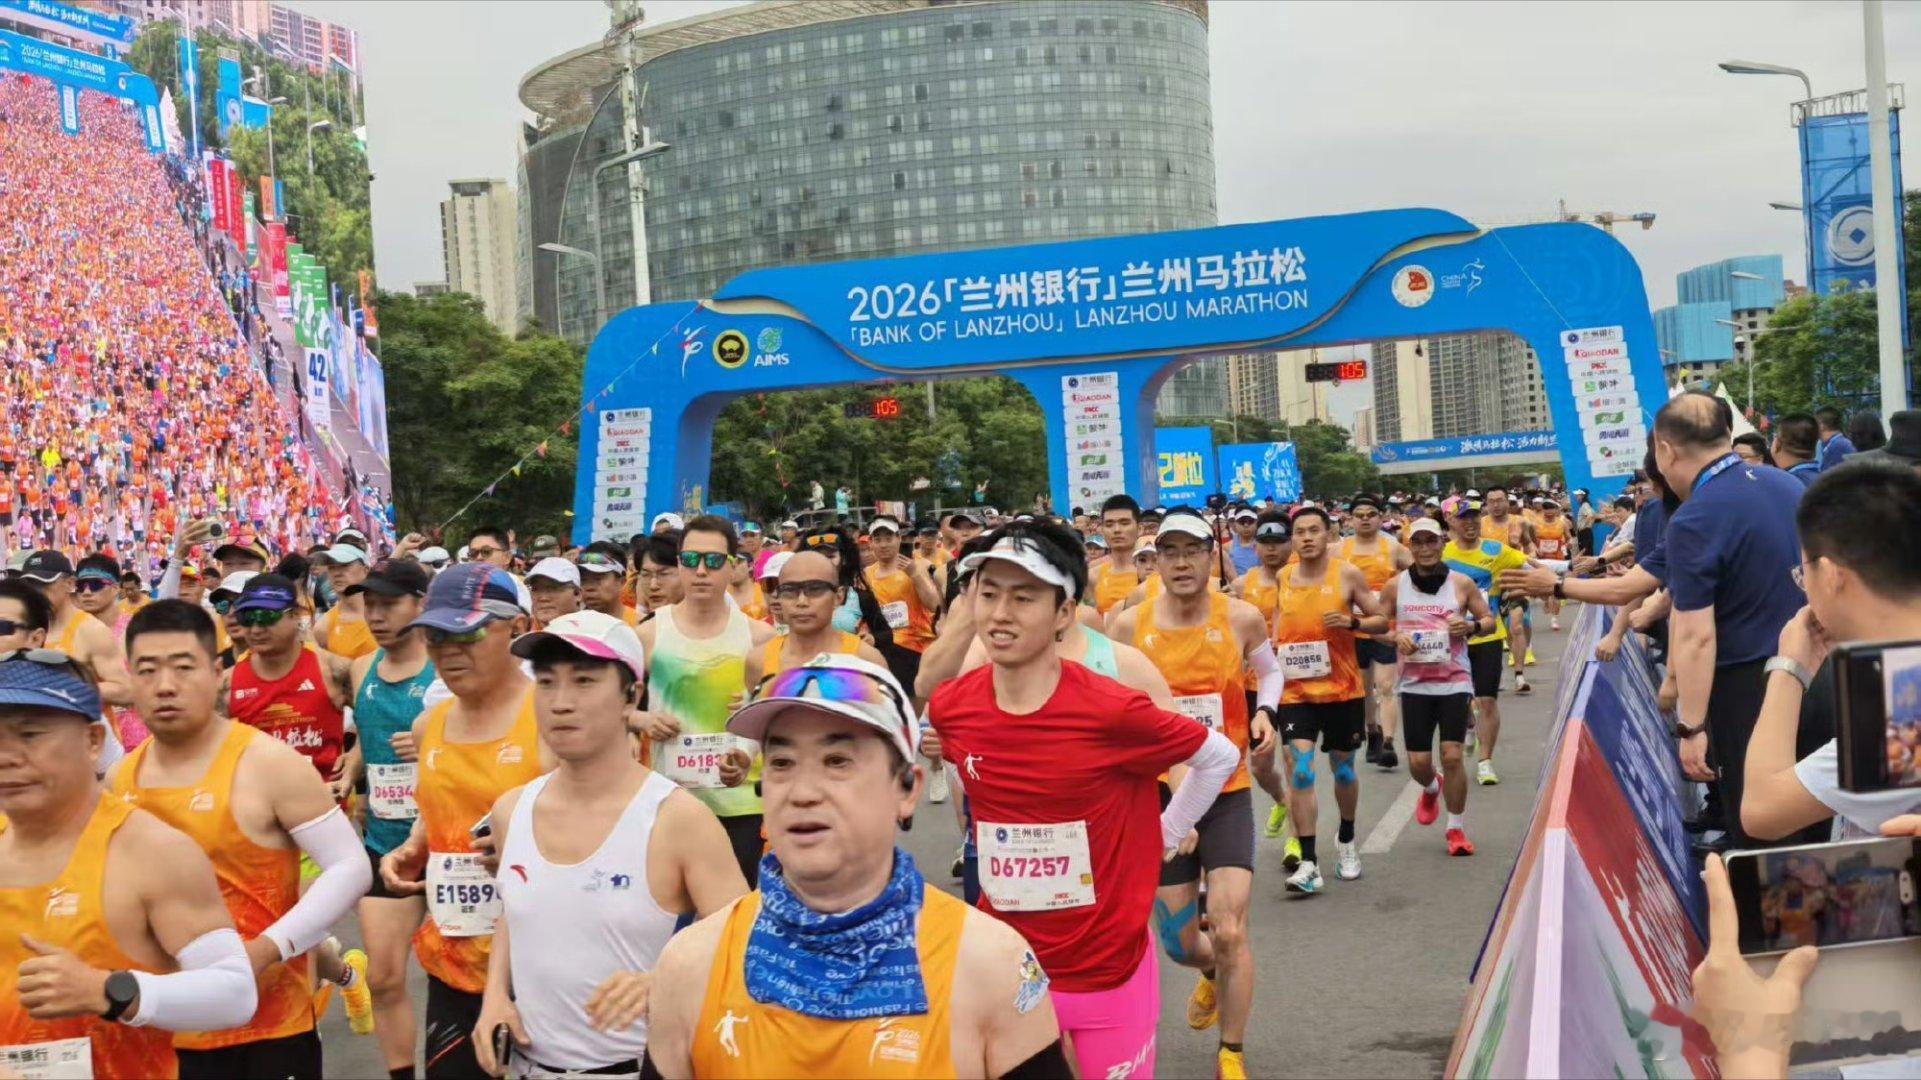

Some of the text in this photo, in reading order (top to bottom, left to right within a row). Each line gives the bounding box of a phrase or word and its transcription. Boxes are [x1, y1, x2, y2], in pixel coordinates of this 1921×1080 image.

[847, 246, 1308, 322] 2026「兰州银行」兰州马拉松
[919, 320, 947, 342] OF
[1075, 300, 1178, 329] LANZHOU
[1186, 289, 1308, 319] MARATHON
[309, 353, 326, 382] 42
[753, 353, 790, 367] AIMS
[1404, 604, 1445, 613] saucony
[1012, 827, 1055, 839] 兰州银行
[990, 855, 1071, 878] D67257
[436, 884, 502, 904] E1589
